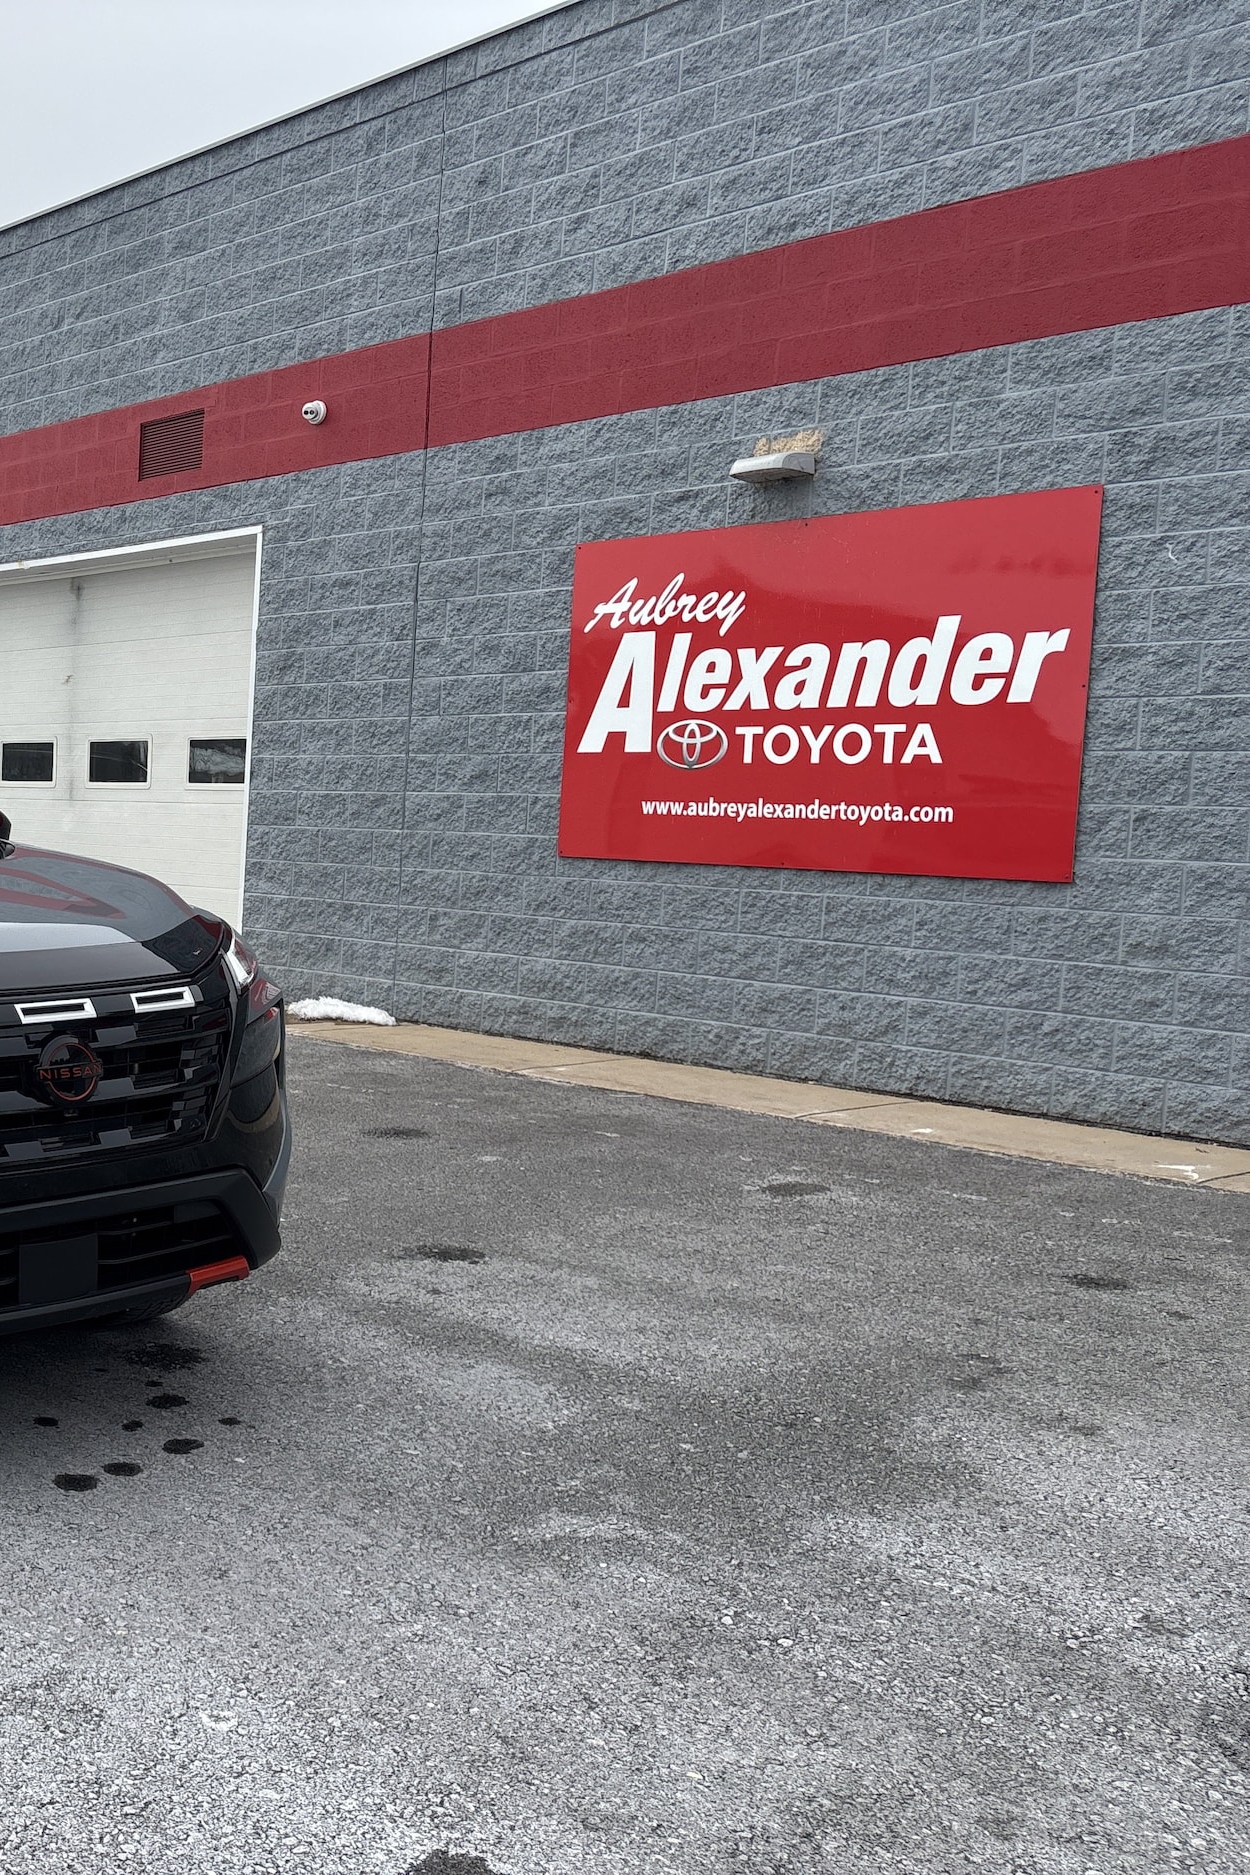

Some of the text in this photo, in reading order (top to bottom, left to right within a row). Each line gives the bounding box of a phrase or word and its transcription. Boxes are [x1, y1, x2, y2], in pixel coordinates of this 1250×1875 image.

[584, 573, 746, 636] Aubrey
[577, 615, 1070, 753] Alexander
[735, 723, 943, 764] TOYOTA
[641, 797, 954, 826] www.aubreyalexandertoyota.com
[39, 1064, 102, 1080] NISSAN
